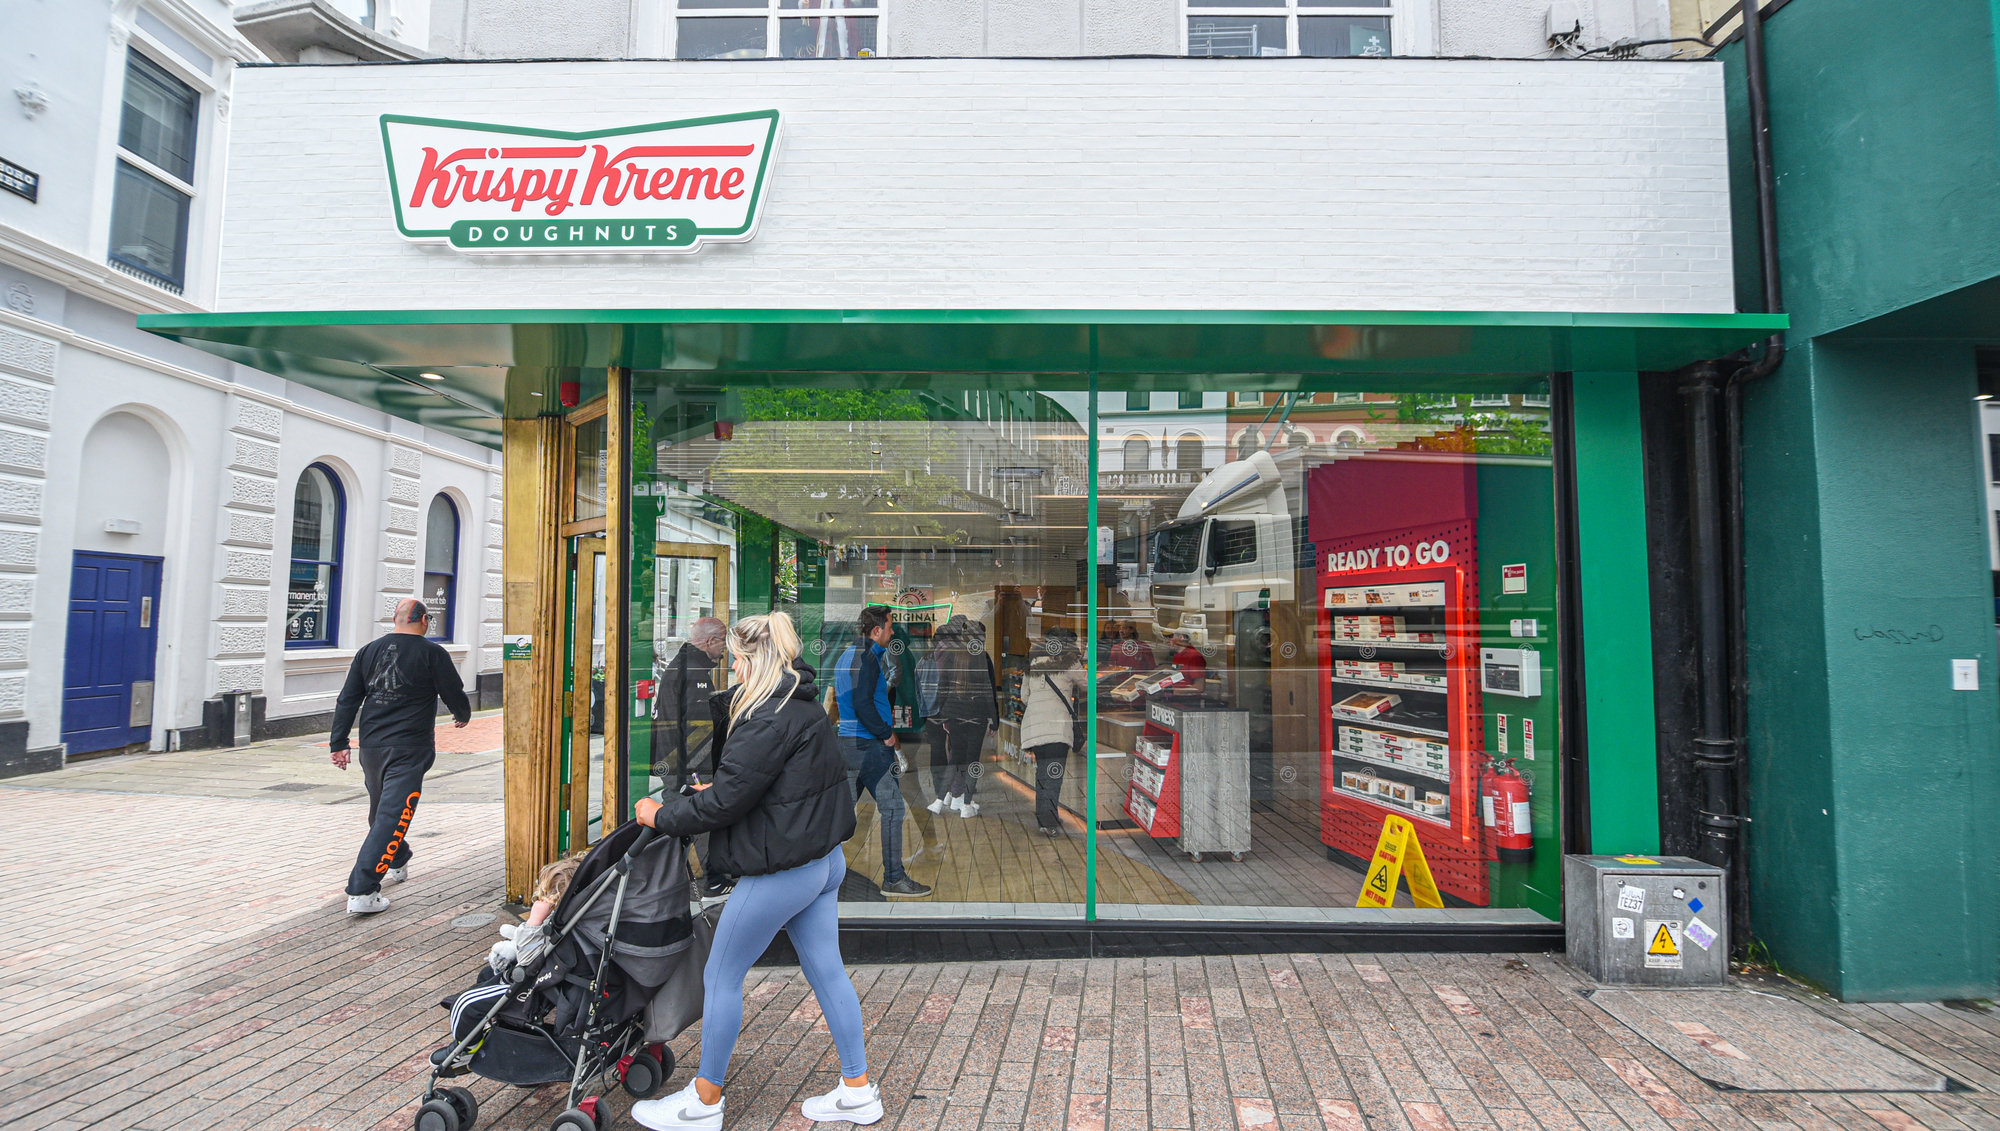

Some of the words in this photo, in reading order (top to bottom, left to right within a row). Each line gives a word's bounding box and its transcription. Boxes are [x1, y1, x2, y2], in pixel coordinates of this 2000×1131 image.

[409, 145, 586, 216] Krispy
[579, 143, 755, 207] Kreme
[468, 225, 678, 242] DOUGHNUTS
[1327, 547, 1381, 573] READY
[1384, 544, 1410, 567] TO
[1415, 539, 1450, 565] GO
[891, 612, 938, 622] RIGINAL
[1151, 704, 1176, 727] EXPRESS
[375, 791, 421, 874] Carrots
